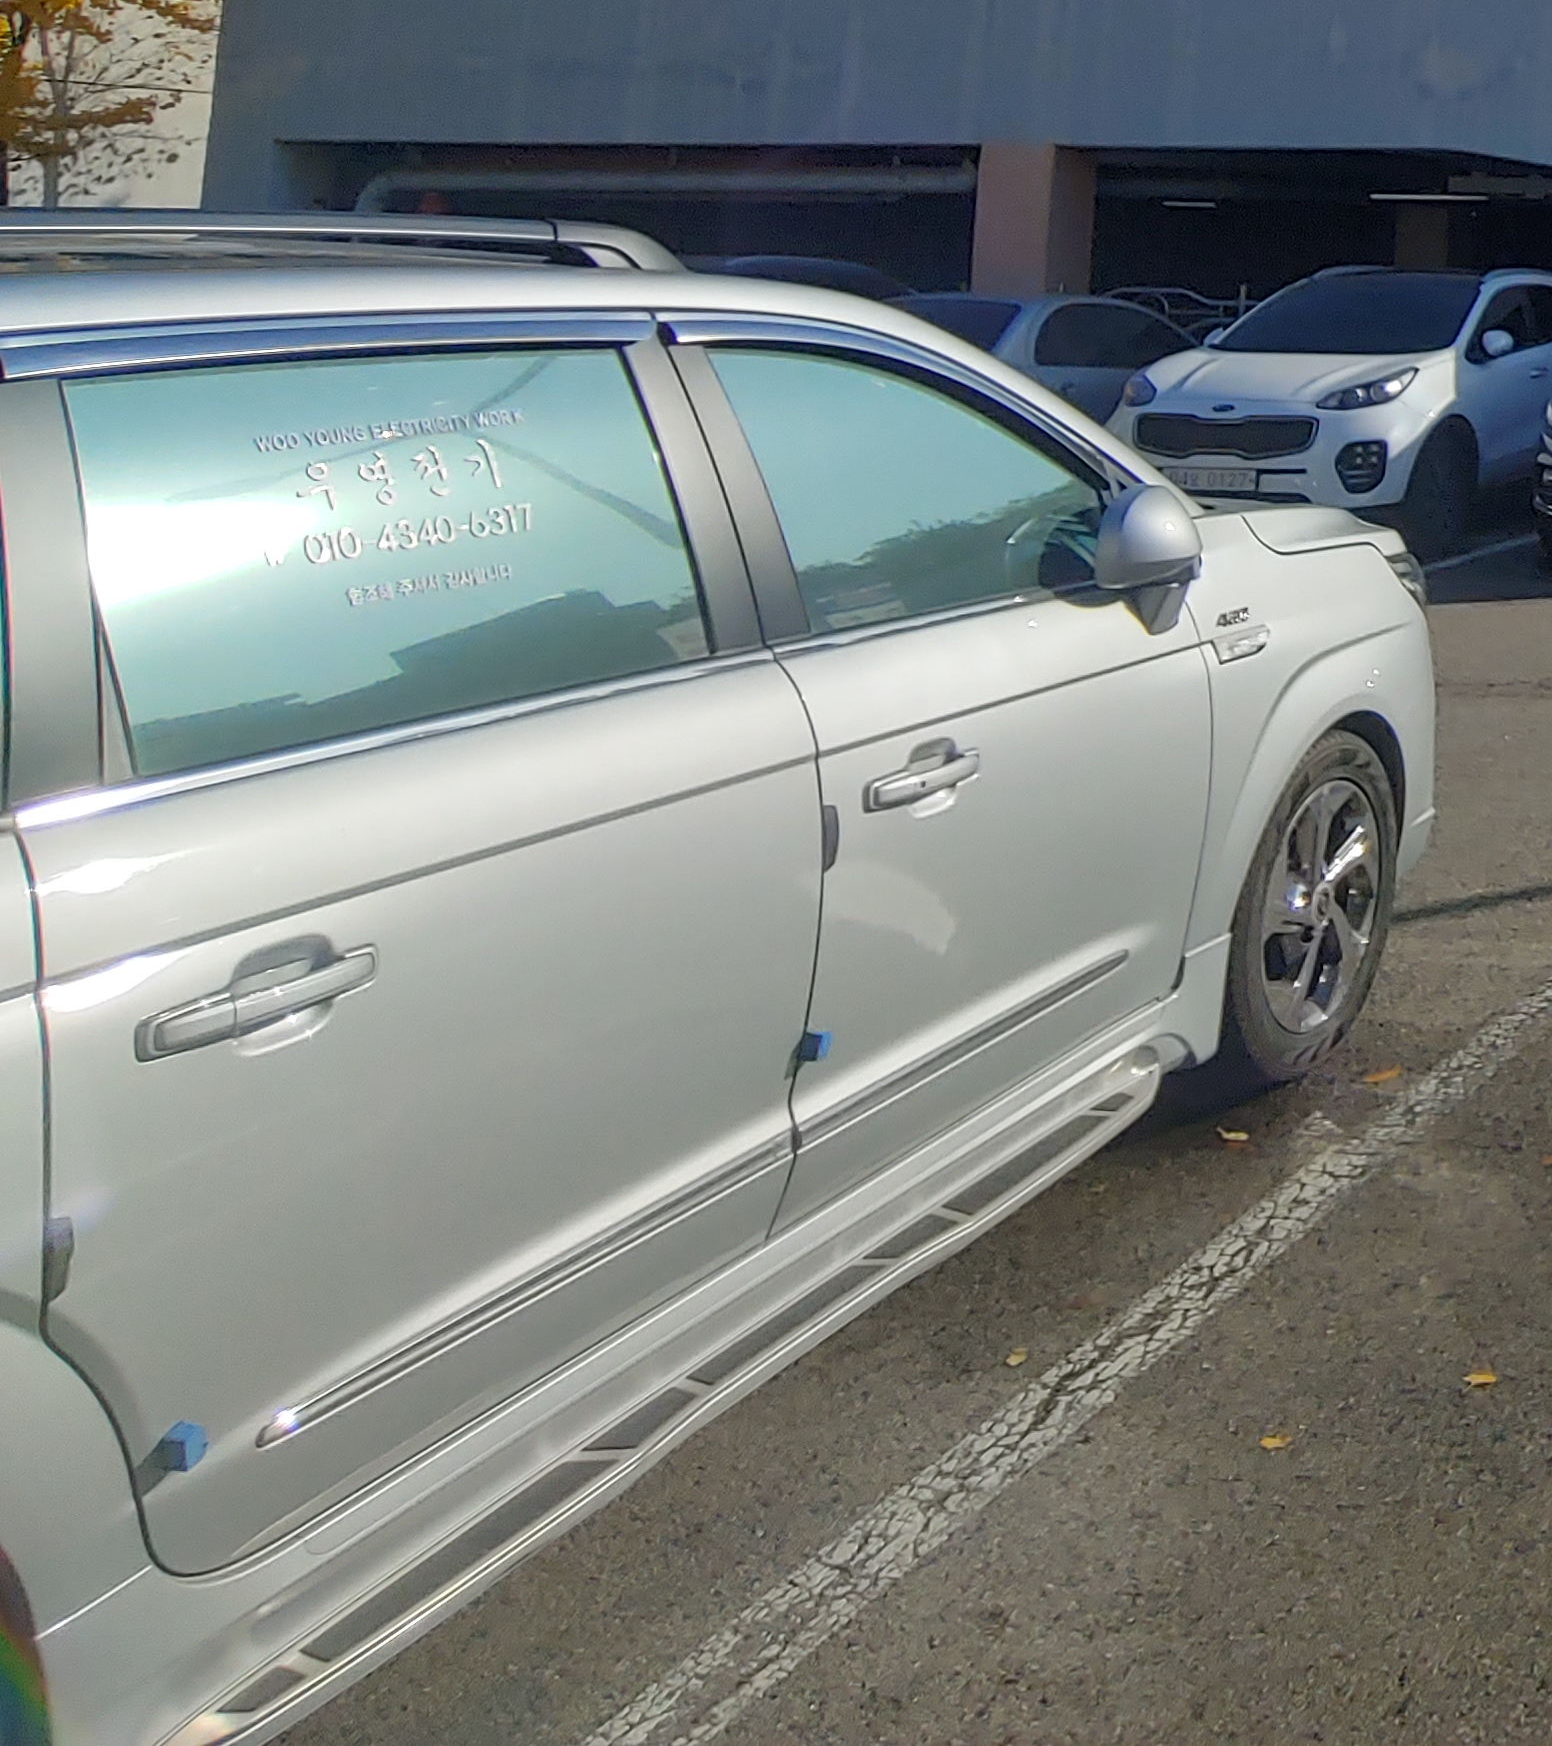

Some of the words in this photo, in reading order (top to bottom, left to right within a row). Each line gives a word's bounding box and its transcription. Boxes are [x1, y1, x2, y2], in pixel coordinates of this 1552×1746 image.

[253, 431, 299, 454] WOO
[302, 424, 367, 448] YOUNG
[472, 408, 525, 430] WORK
[296, 438, 503, 511] 우영전기
[303, 502, 534, 565] 010-4340-6317
